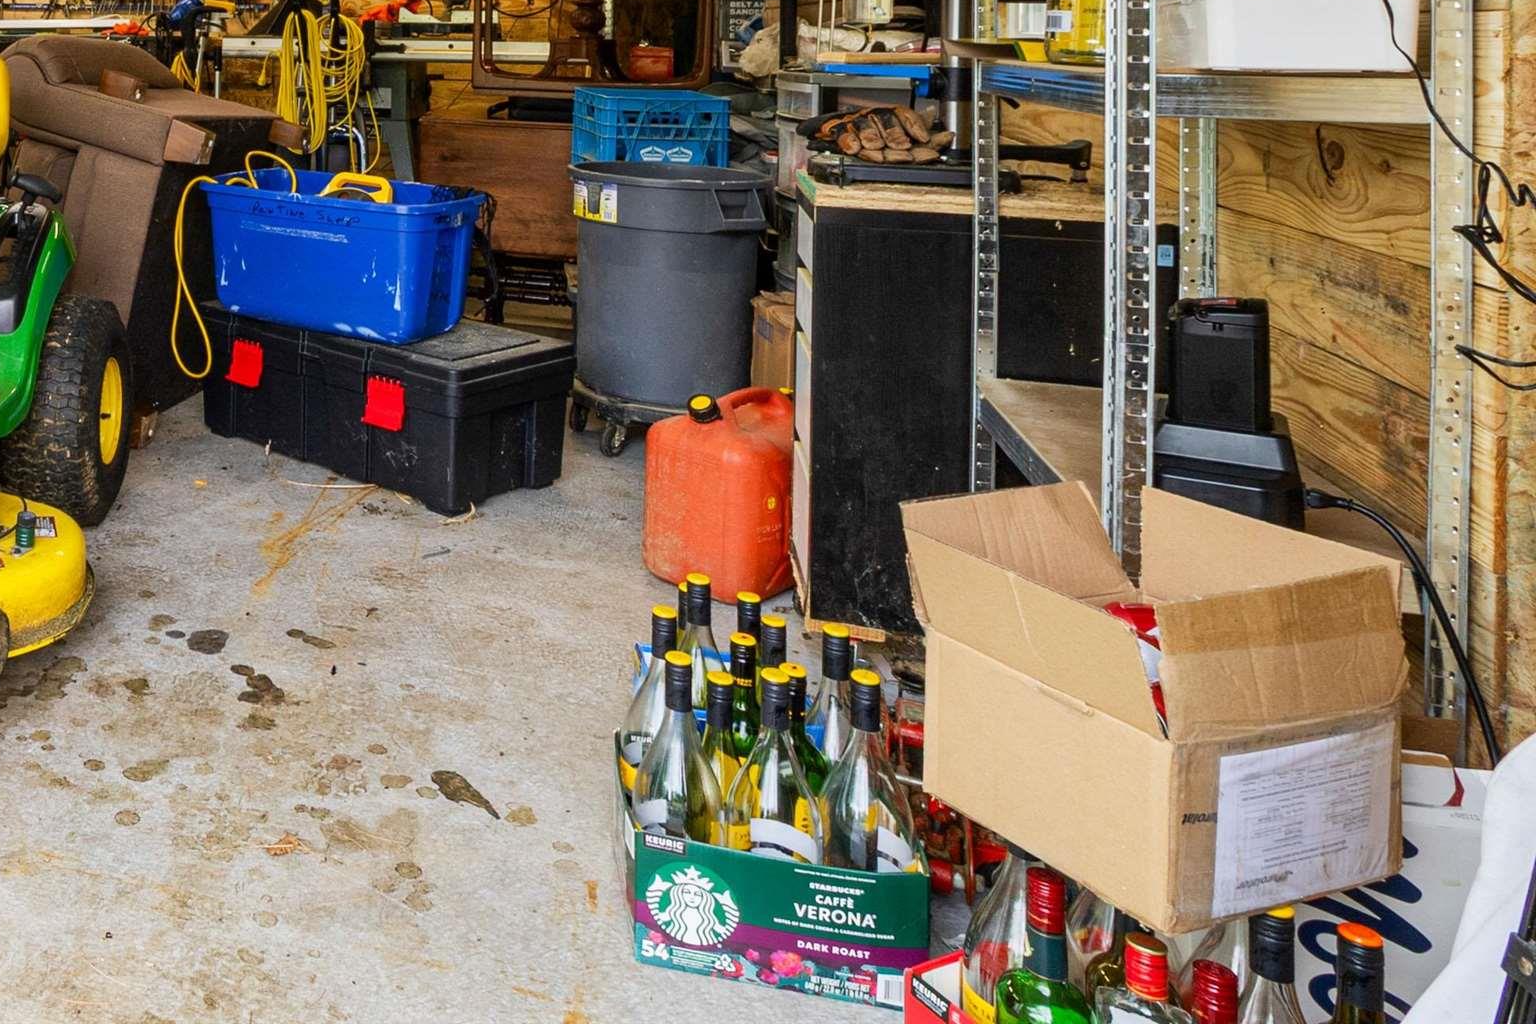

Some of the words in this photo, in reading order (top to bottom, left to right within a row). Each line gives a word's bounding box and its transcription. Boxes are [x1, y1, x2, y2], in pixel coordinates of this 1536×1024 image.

[645, 834, 684, 850] KEURIG
[809, 881, 864, 896] STARBUCKS
[815, 893, 854, 909] CAFFÈ
[794, 902, 876, 929] VERONA
[641, 939, 670, 960] 54
[797, 939, 829, 954] DARK
[832, 945, 870, 961] ROAST
[911, 976, 949, 1012] KEURIG
